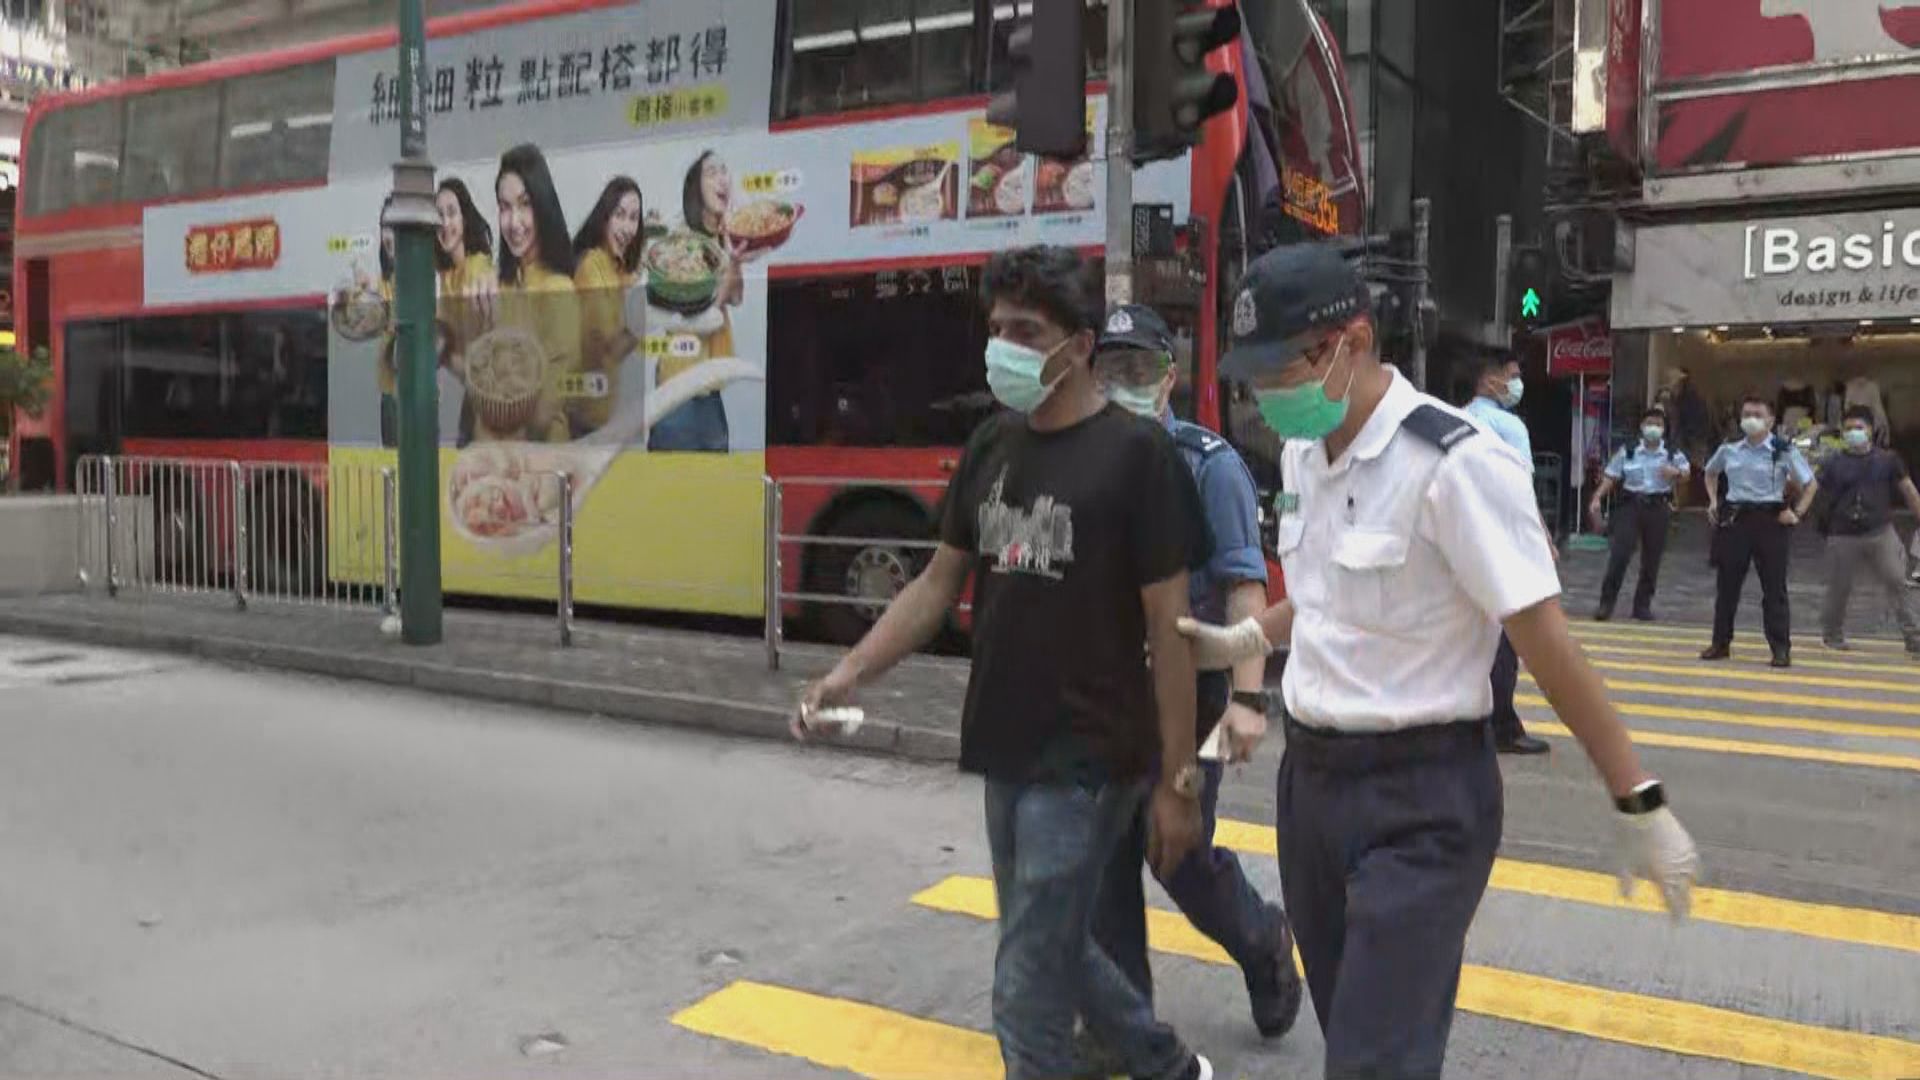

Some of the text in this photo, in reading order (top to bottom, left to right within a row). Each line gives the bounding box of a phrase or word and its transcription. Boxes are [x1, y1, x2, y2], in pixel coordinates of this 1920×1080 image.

[1779, 284, 1919, 306] design & life
